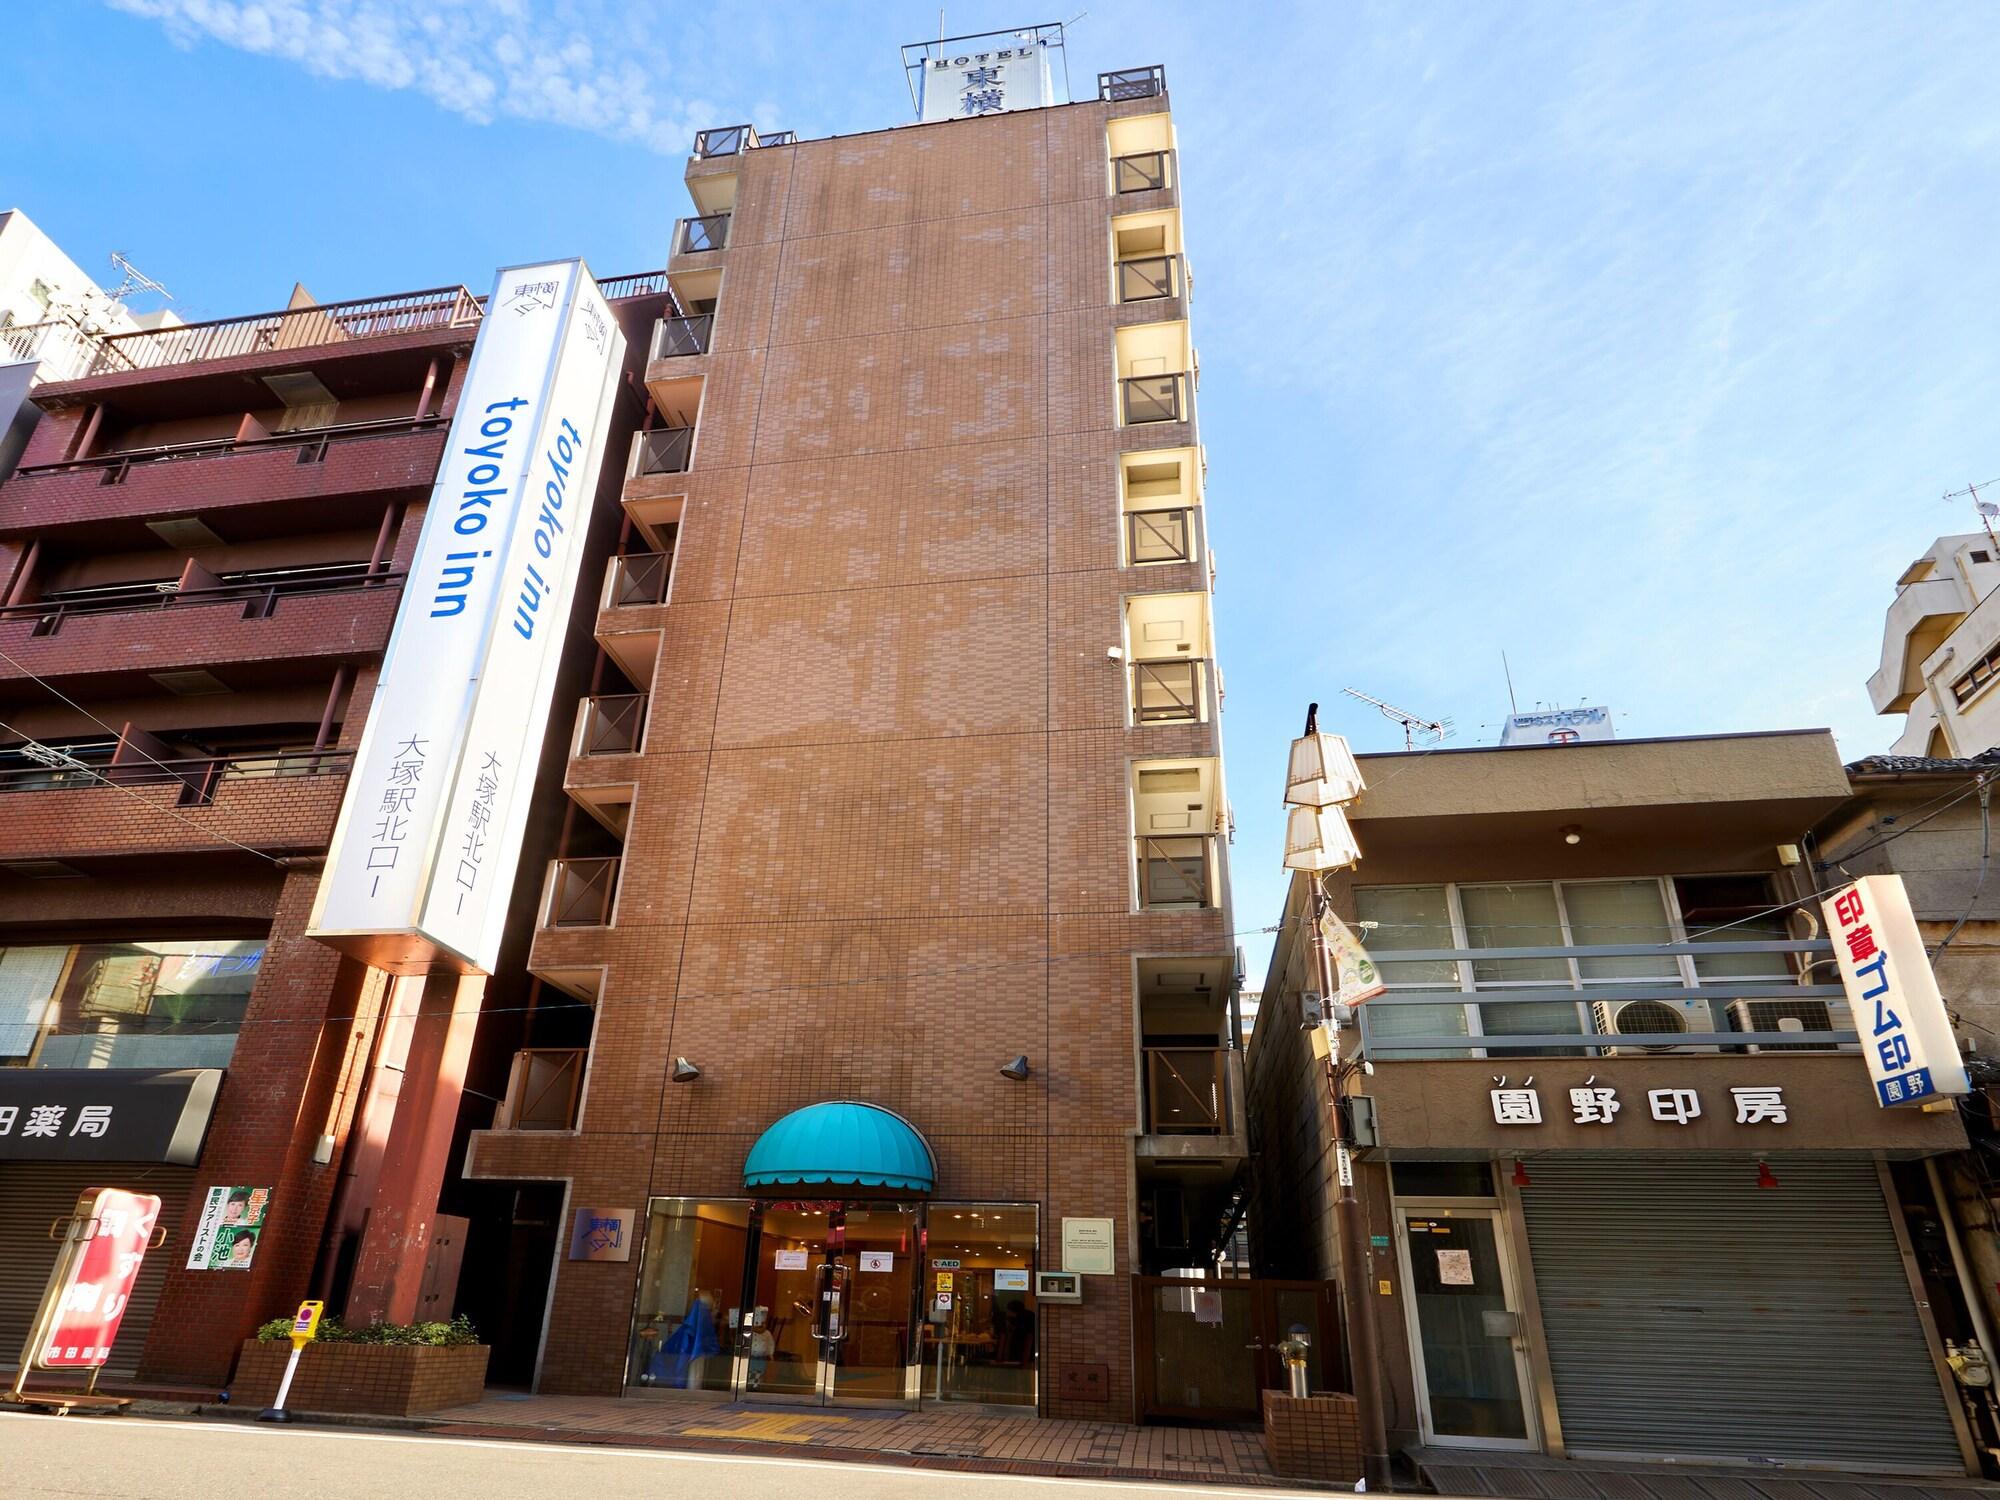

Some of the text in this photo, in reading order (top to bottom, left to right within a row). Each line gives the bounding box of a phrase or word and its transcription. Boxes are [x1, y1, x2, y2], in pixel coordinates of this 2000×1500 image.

[934, 48, 1032, 70] HOTEL
[960, 65, 1006, 114] 東横
[430, 396, 529, 619] toyoko inn
[513, 417, 583, 641] toyoko inn
[1490, 1086, 1788, 1125] 園野印房
[212, 1228, 235, 1261] 小池
[941, 1260, 960, 1268] AED
